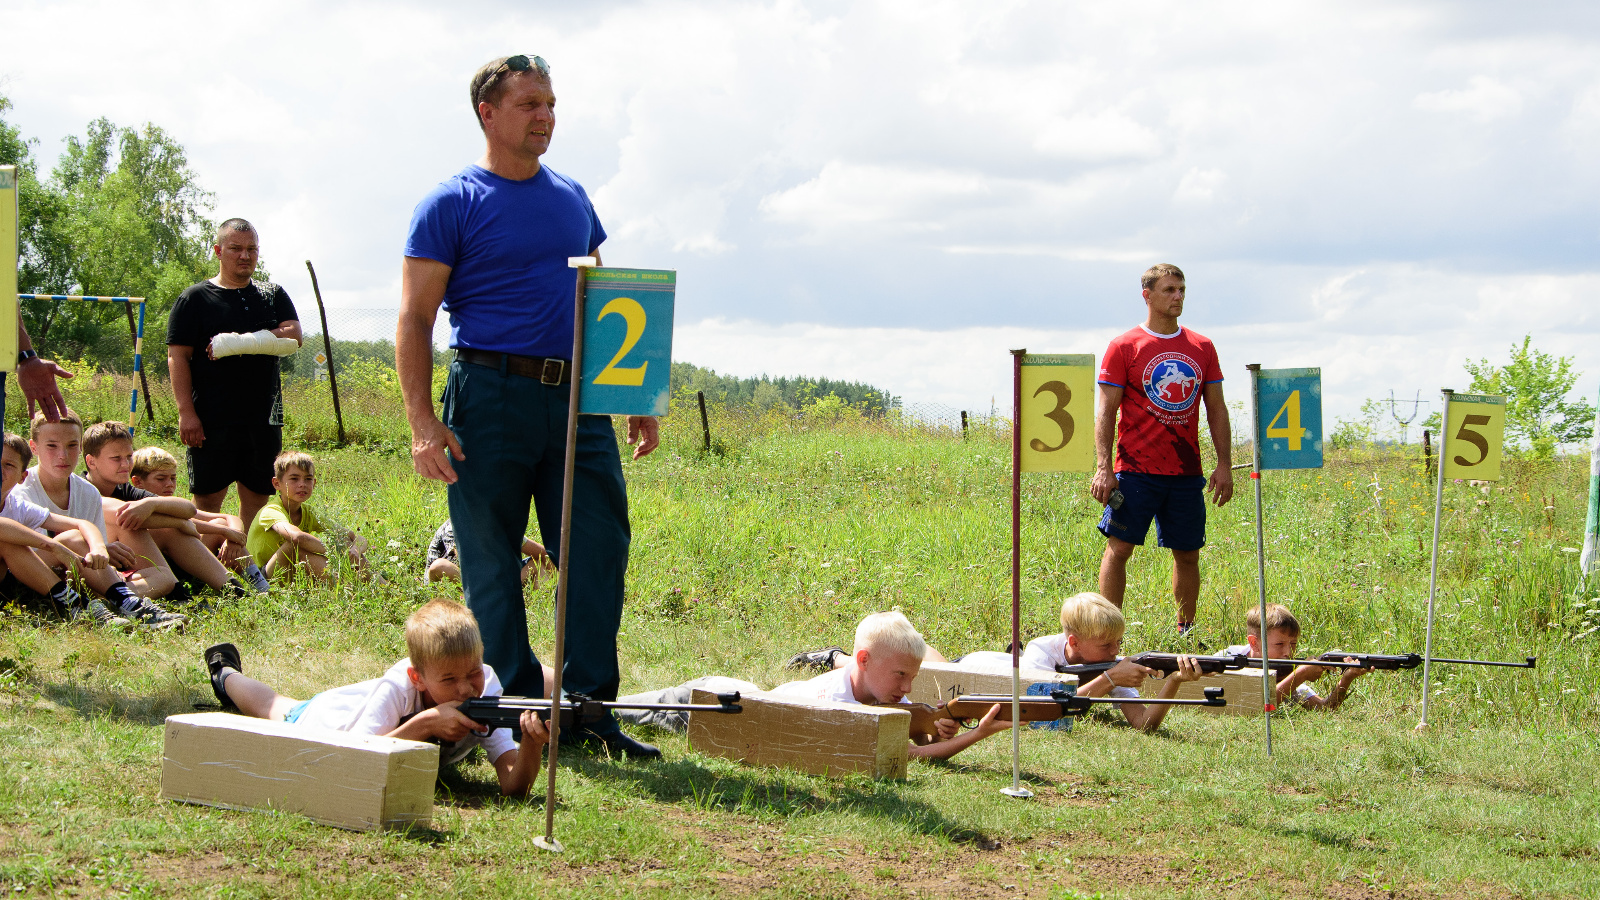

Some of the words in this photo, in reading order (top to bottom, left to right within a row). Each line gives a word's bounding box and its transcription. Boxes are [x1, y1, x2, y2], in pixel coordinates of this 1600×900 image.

[592, 297, 648, 386] 2
[1030, 381, 1075, 452] 3
[1266, 390, 1306, 450] 4
[1454, 414, 1491, 466] 5
[948, 684, 965, 699] 14
